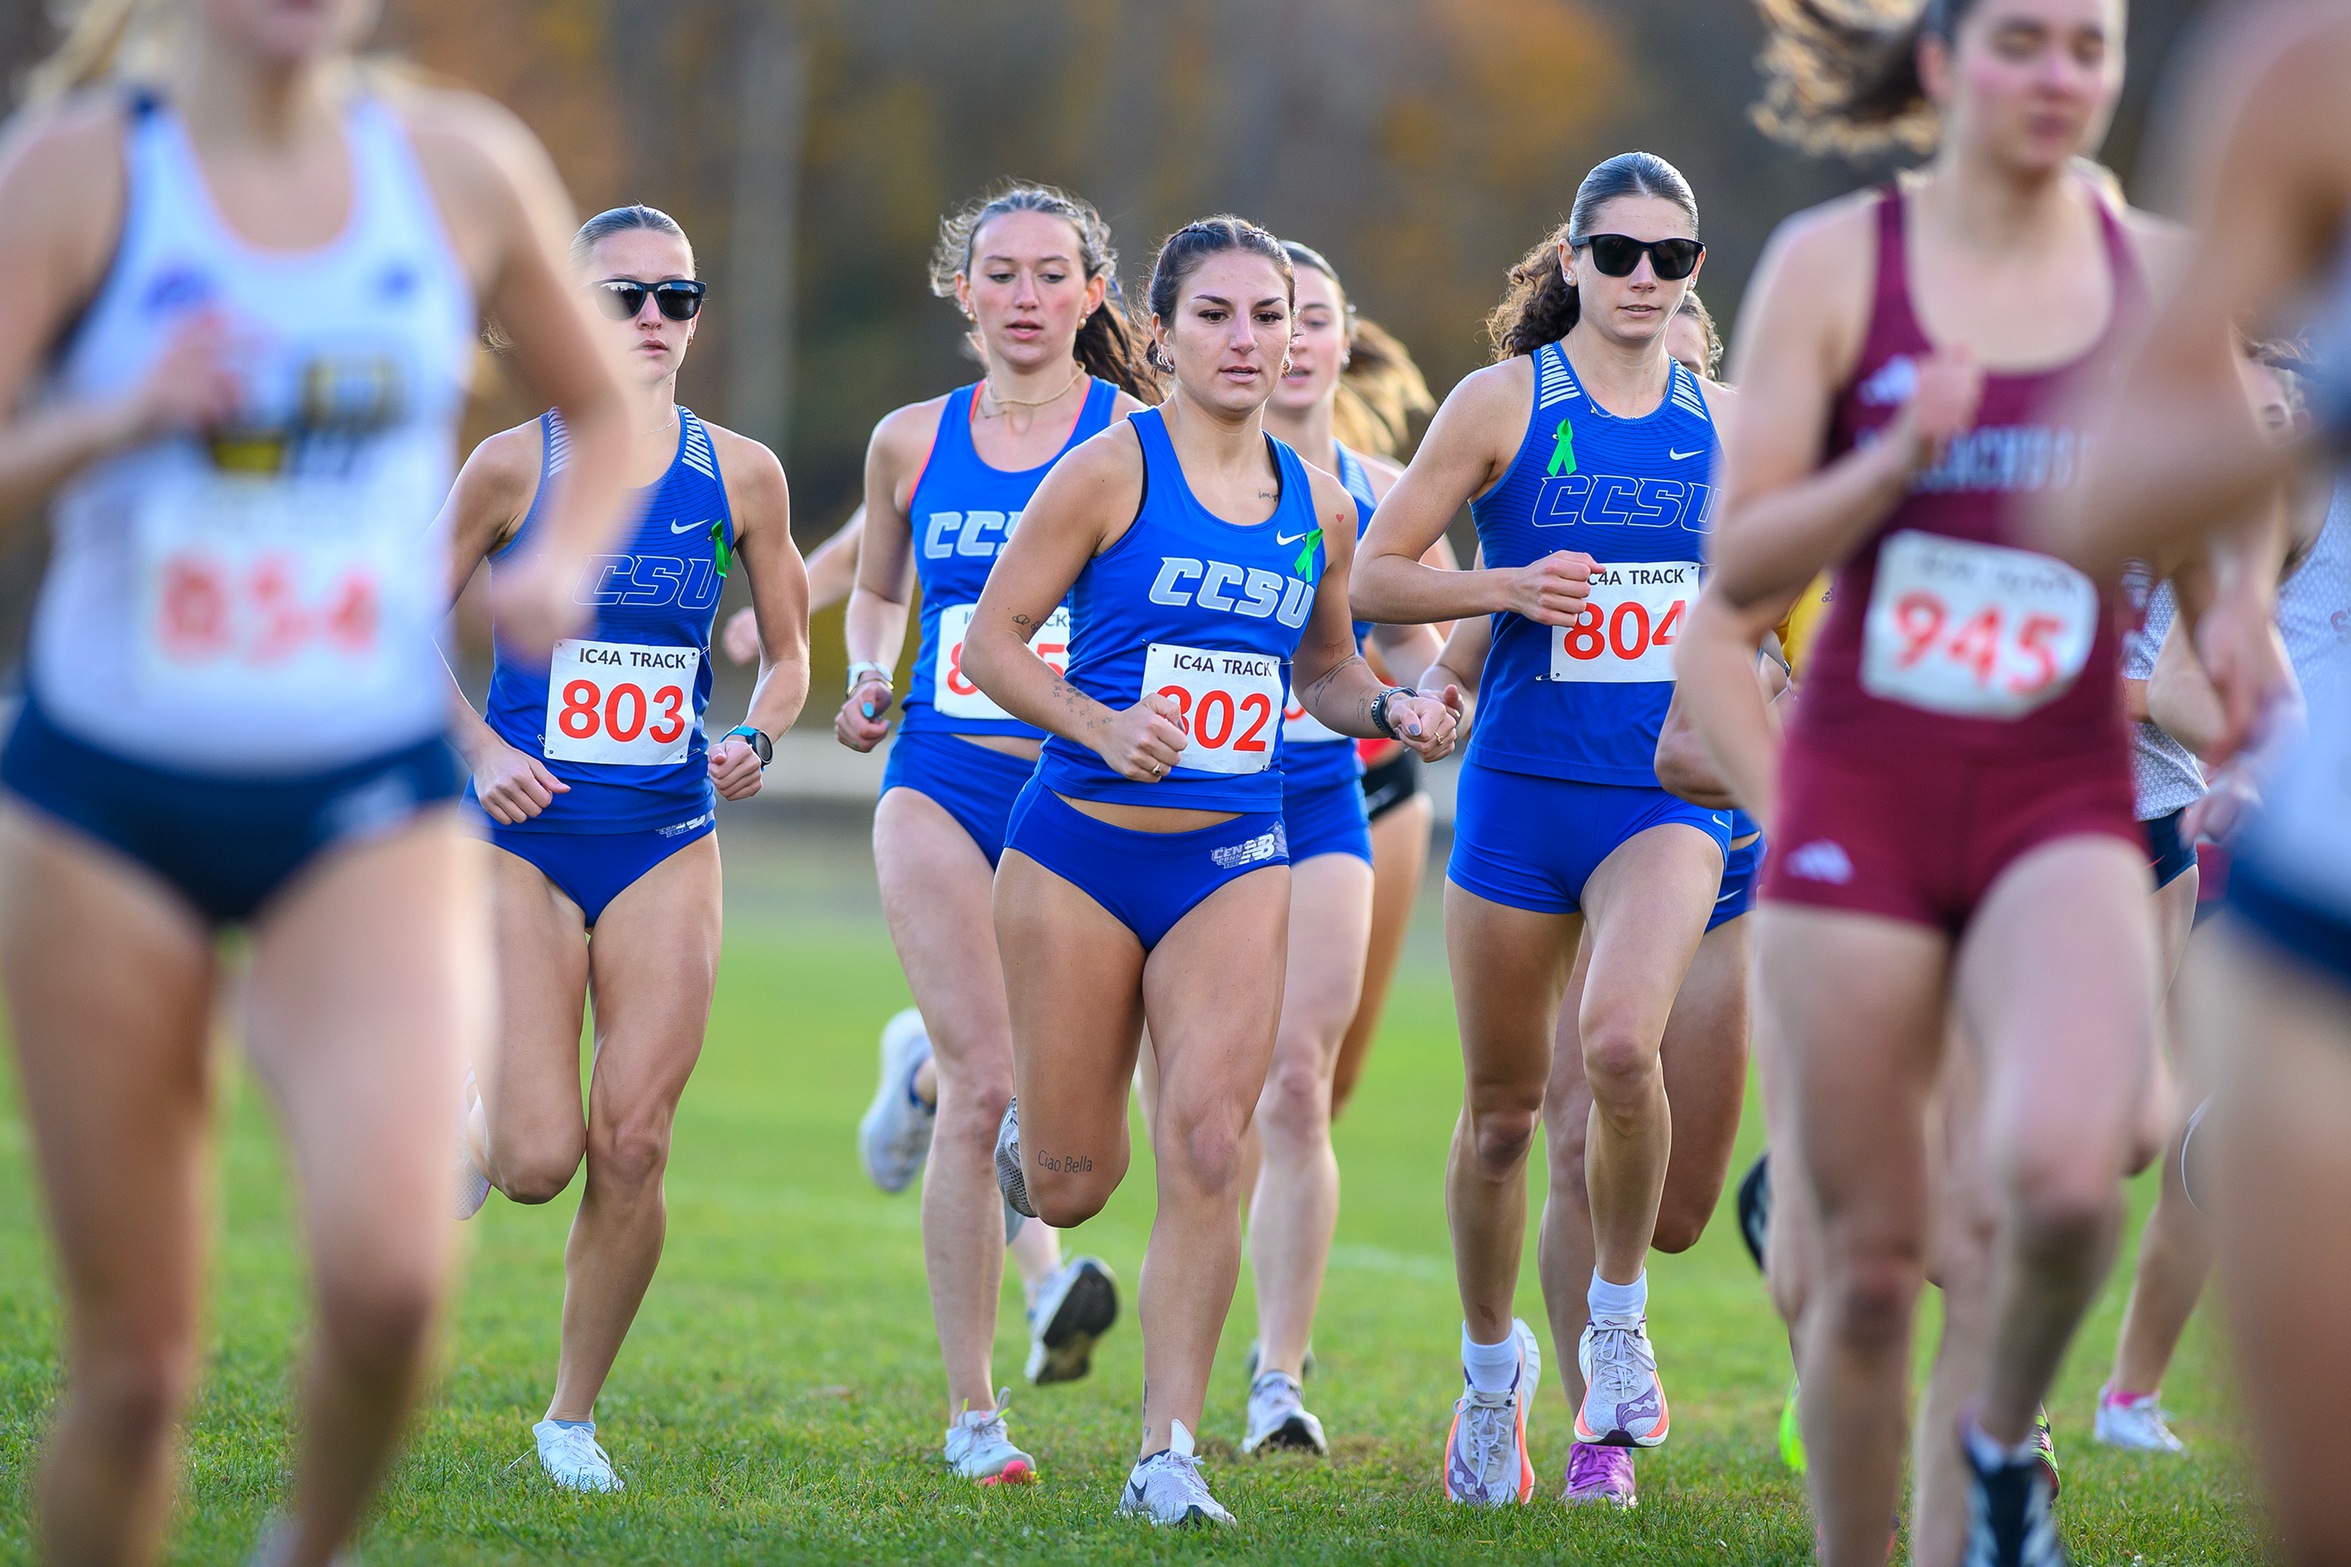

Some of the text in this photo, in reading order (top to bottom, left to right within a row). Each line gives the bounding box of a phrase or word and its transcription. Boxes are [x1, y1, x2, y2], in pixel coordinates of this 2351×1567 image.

[1531, 475, 1723, 534] CCSU
[537, 554, 722, 610] CSU
[1148, 556, 1315, 630] CCSU
[1587, 568, 1685, 586] C4A TRACK
[579, 648, 687, 669] IC4A TRACK
[1563, 600, 1687, 660] 804
[1893, 590, 2069, 697] 945
[1173, 653, 1272, 677] IC4A TRACK
[558, 679, 686, 744] 803
[1038, 1149, 1093, 1173] Ciao Bella
